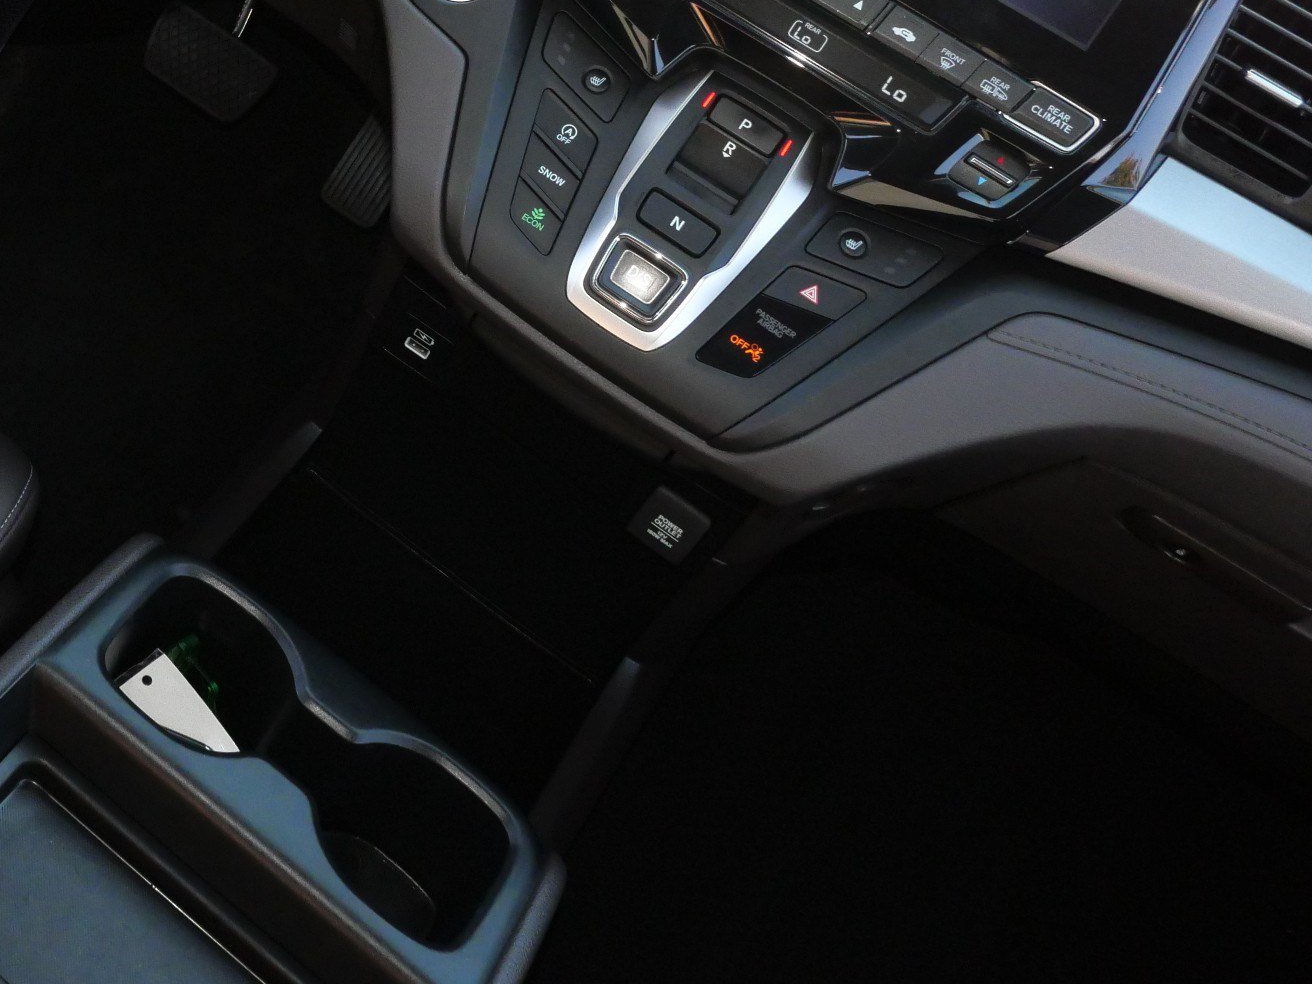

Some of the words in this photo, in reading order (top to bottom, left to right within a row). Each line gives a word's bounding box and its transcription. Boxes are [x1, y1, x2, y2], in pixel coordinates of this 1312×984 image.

[793, 26, 811, 45] Lo
[804, 22, 822, 35] REAR
[940, 47, 966, 66] FRONT
[881, 75, 907, 103] Lo
[989, 76, 1011, 91] REAR
[1030, 104, 1073, 134] CLIMATE
[1047, 104, 1071, 123] REAR
[738, 118, 753, 131] P
[556, 133, 572, 146] OFF
[723, 140, 737, 156] R
[538, 165, 567, 187] SNOW
[521, 213, 546, 232] ECON
[669, 215, 686, 232] N
[755, 308, 797, 339] PASSENGER
[756, 318, 785, 339] AIRBAG
[729, 334, 751, 350] OFF
[654, 518, 682, 539] OUTLET
[658, 514, 684, 535] POWER
[659, 538, 673, 549] MAX
